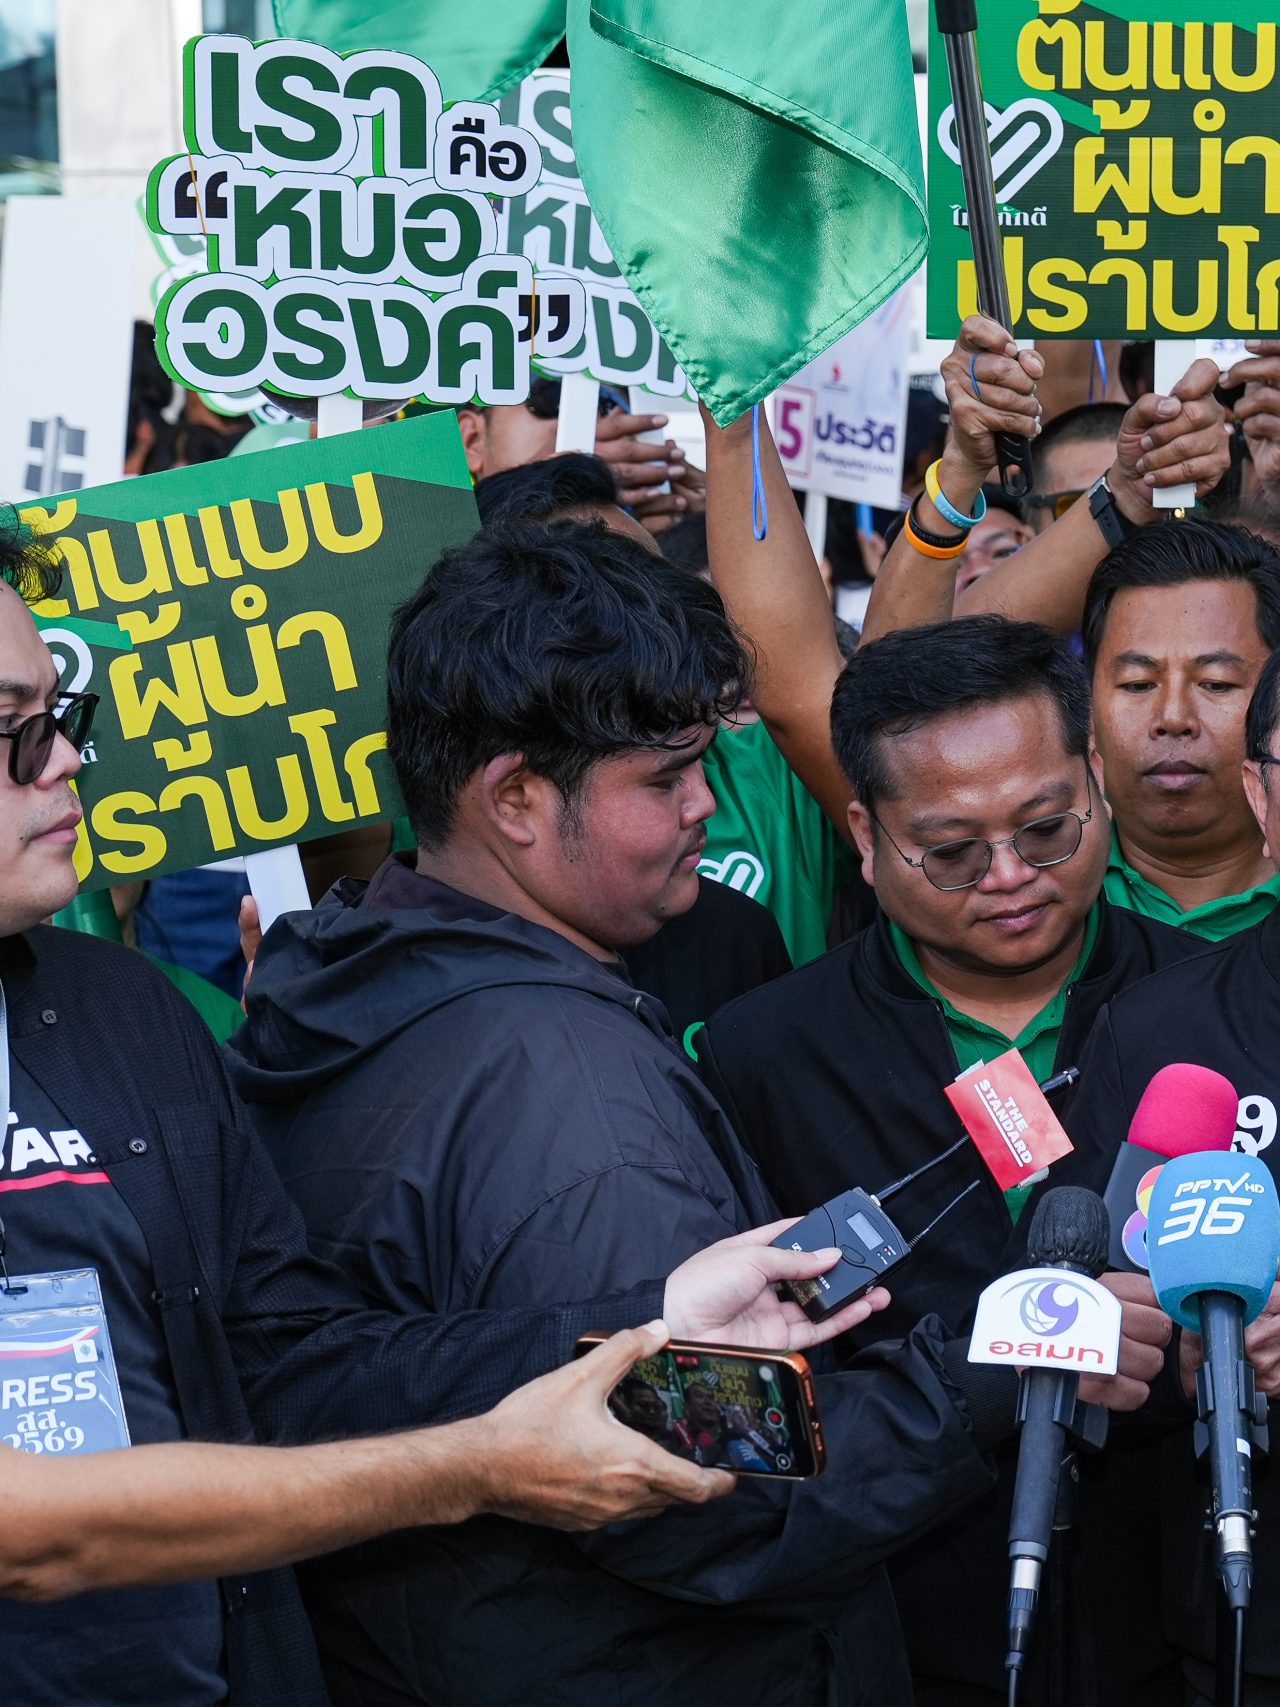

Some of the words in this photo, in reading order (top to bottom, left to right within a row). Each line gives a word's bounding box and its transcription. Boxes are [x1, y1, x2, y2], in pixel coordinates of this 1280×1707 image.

[210, 51, 427, 169] เรา
[450, 117, 527, 182] คือ
[174, 170, 482, 277] “หมอ
[182, 270, 570, 391] วรงค์”
[780, 401, 803, 459] 5
[108, 584, 359, 772] ผู้นำ
[979, 1079, 1033, 1164] STANDARD
[1004, 1096, 1028, 1132] THE
[1174, 1172, 1251, 1198] PPTV
[1244, 1182, 1265, 1194] HD
[1157, 1196, 1253, 1246] 36
[988, 1340, 1105, 1365] อสมท
